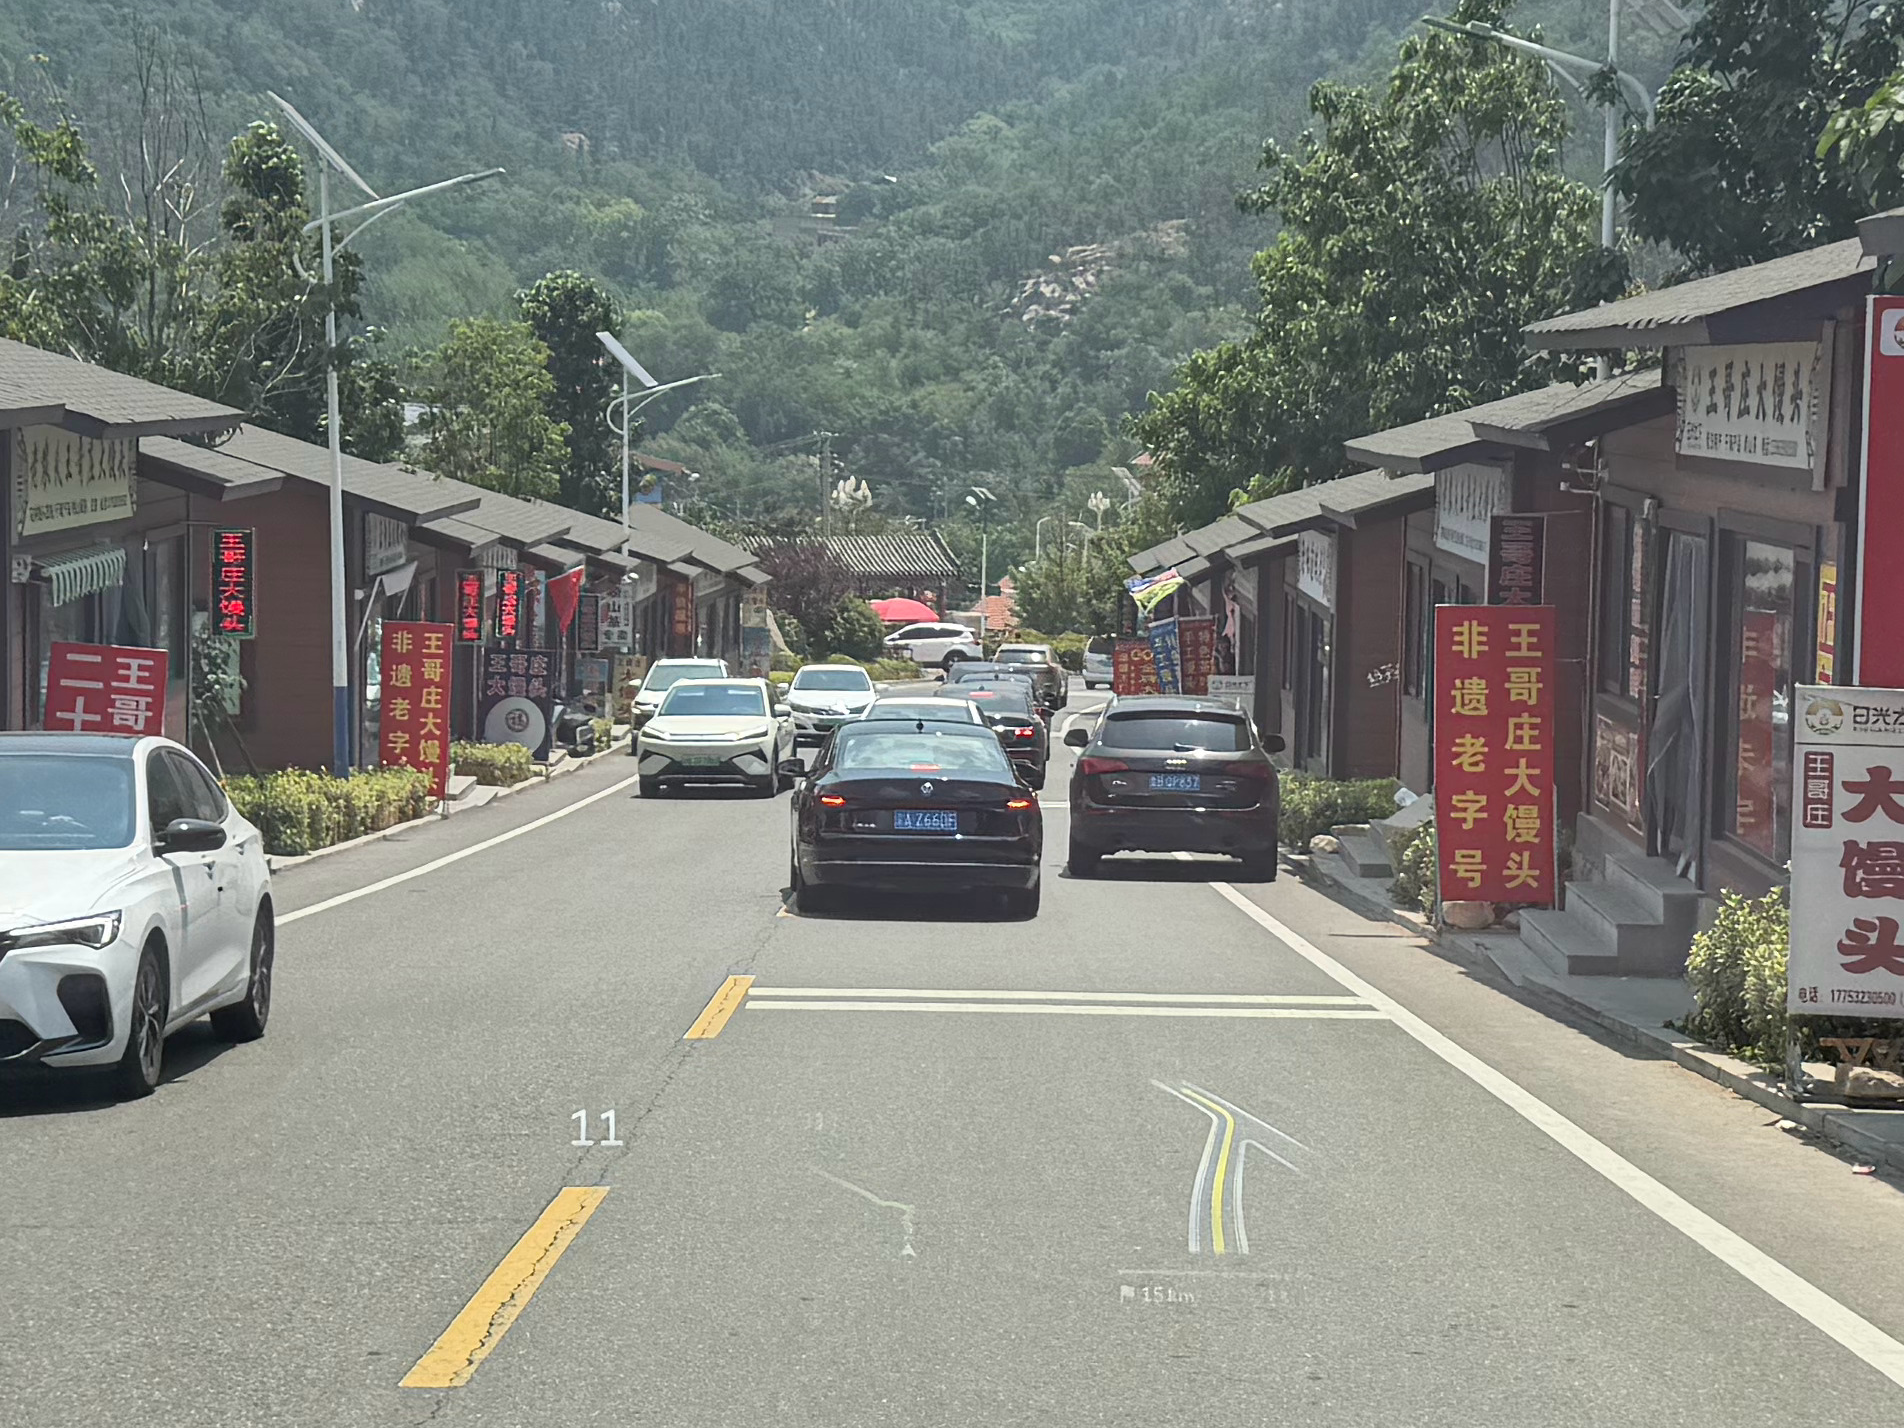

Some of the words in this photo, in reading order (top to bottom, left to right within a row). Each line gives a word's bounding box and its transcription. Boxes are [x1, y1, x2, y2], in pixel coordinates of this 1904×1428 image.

[387, 630, 413, 754] 非遗老字
[1449, 620, 1489, 888] 非遗老字号
[1503, 623, 1543, 889] 王哥庄大馒头
[1807, 754, 1830, 825] 王哥庄
[570, 1108, 625, 1147] 11
